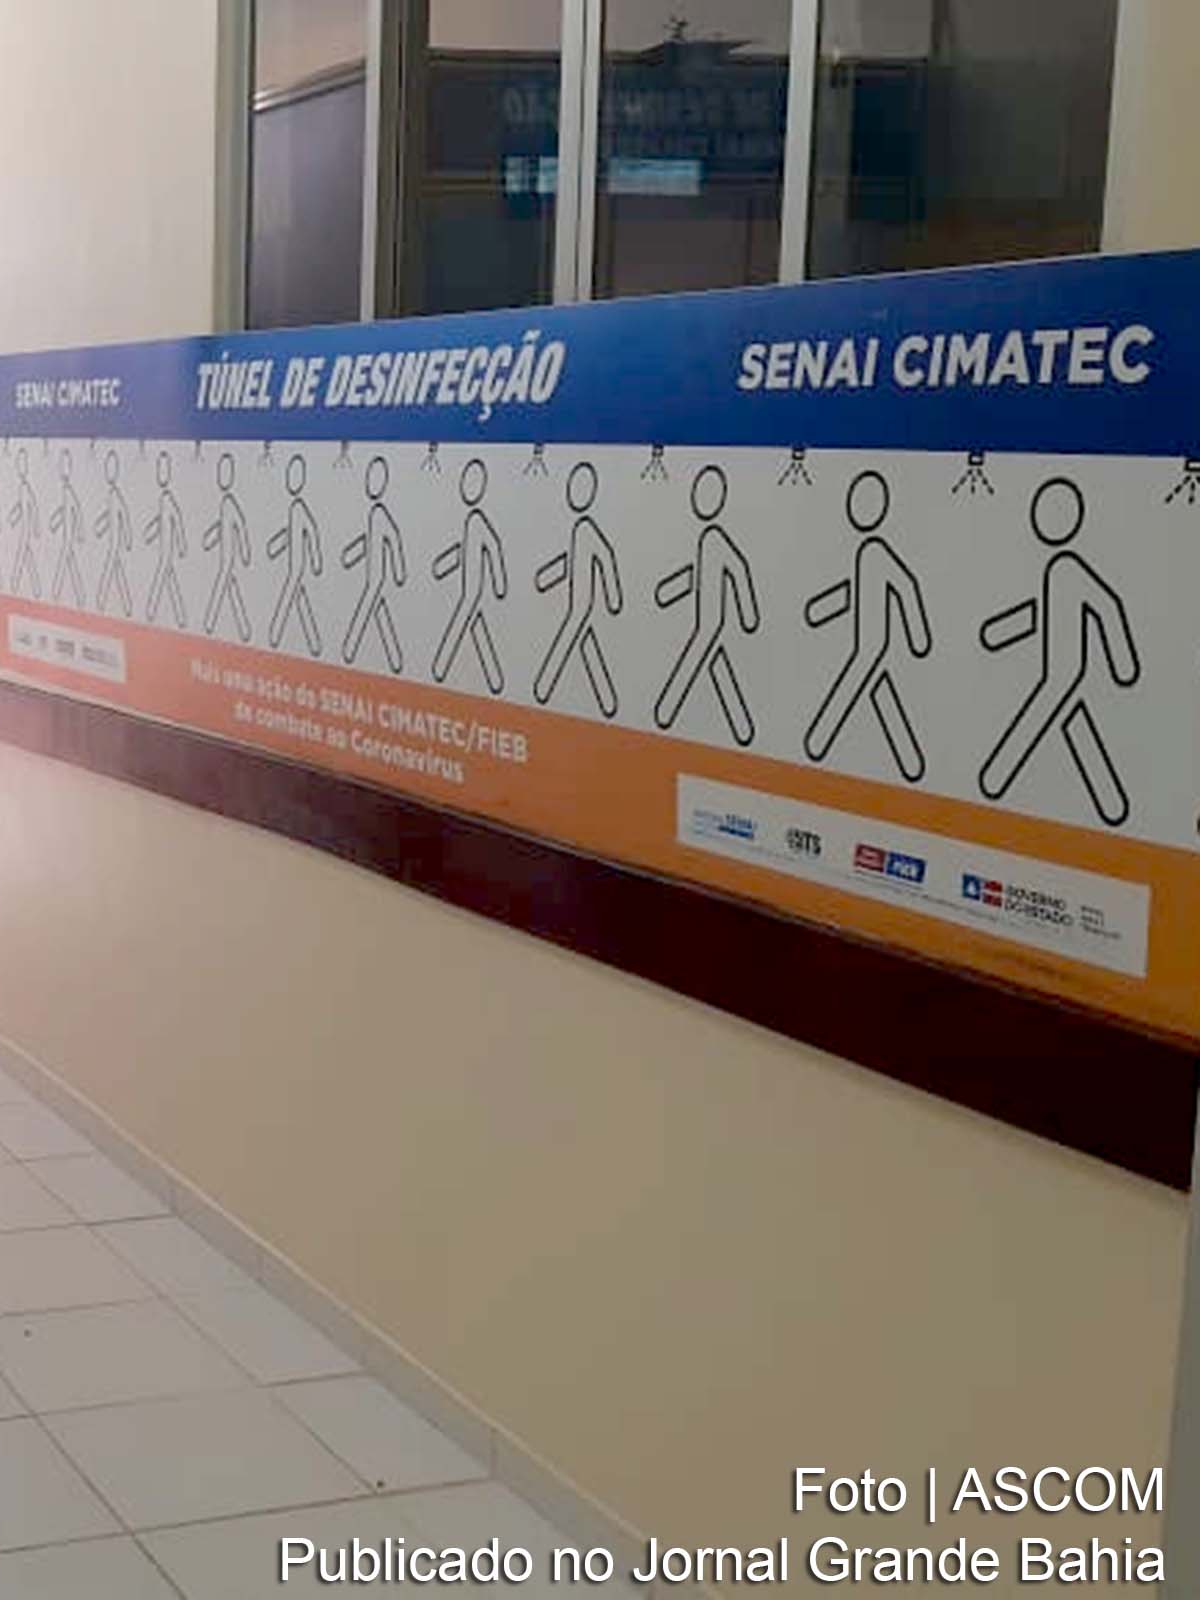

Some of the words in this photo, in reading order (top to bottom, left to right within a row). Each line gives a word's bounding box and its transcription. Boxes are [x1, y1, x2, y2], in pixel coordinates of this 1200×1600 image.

[197, 352, 275, 409] TÚNEL
[280, 357, 326, 409] DE
[324, 330, 565, 421] DESINFECÇÃO
[737, 338, 879, 390] SENAI
[893, 324, 1155, 387] CIMATEC
[15, 380, 55, 408] SENAI
[57, 378, 121, 407] CIMATEC
[319, 688, 374, 724] SENAI
[378, 703, 528, 763] CIMATEC/FIEB
